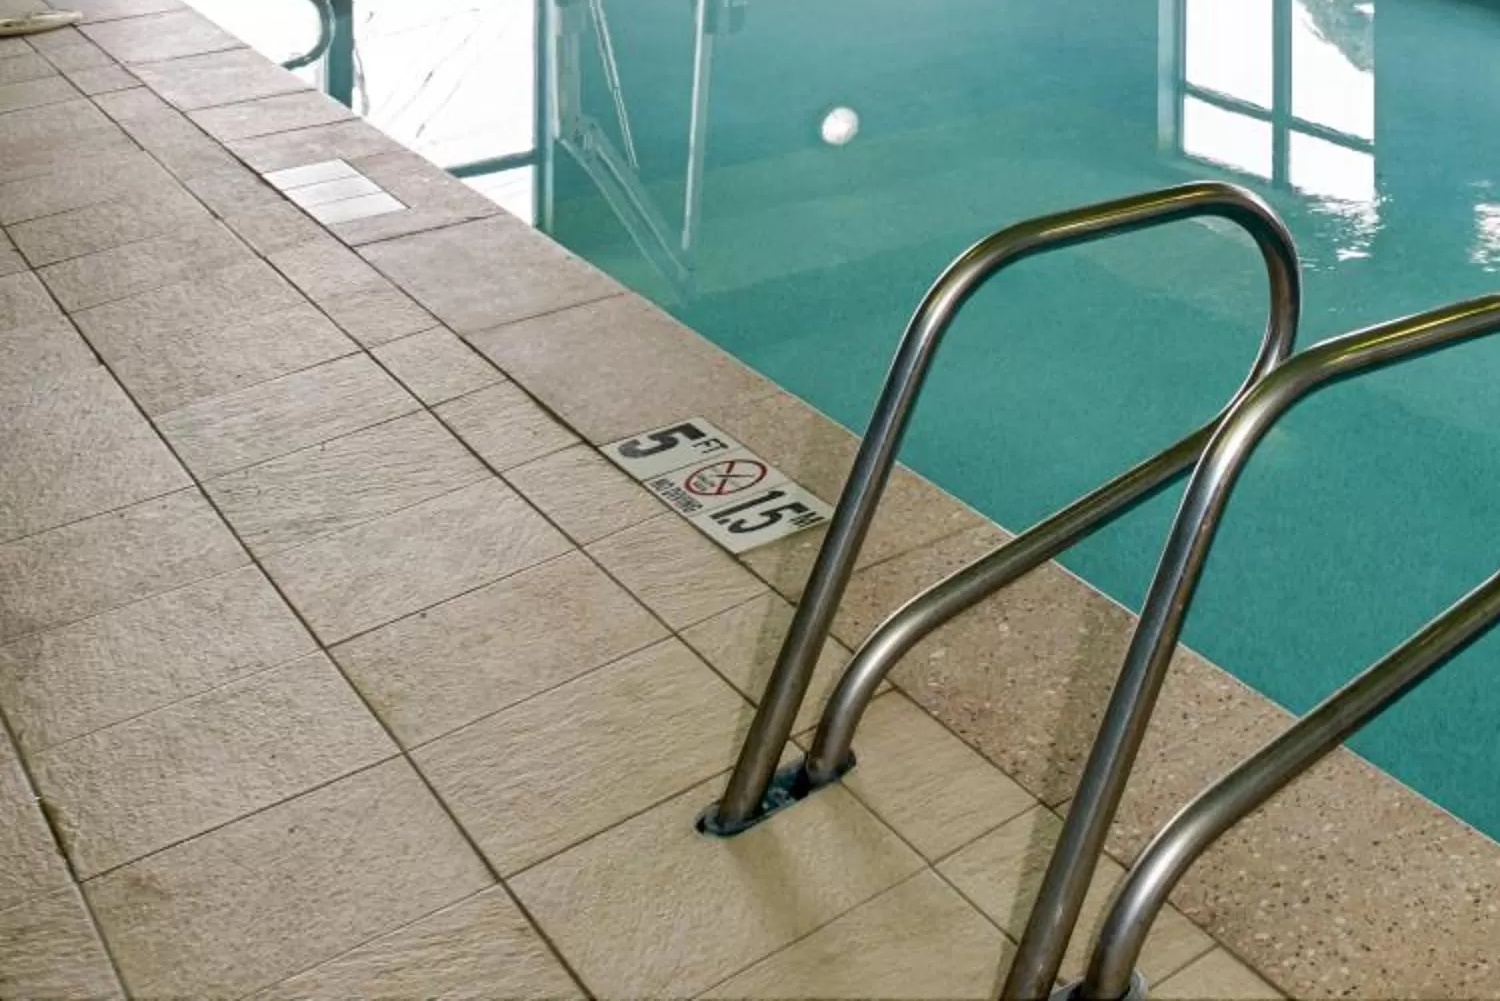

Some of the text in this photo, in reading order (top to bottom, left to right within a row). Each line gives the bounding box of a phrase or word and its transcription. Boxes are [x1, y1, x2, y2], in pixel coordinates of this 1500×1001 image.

[617, 422, 825, 534] 5 FT 1.5 M
